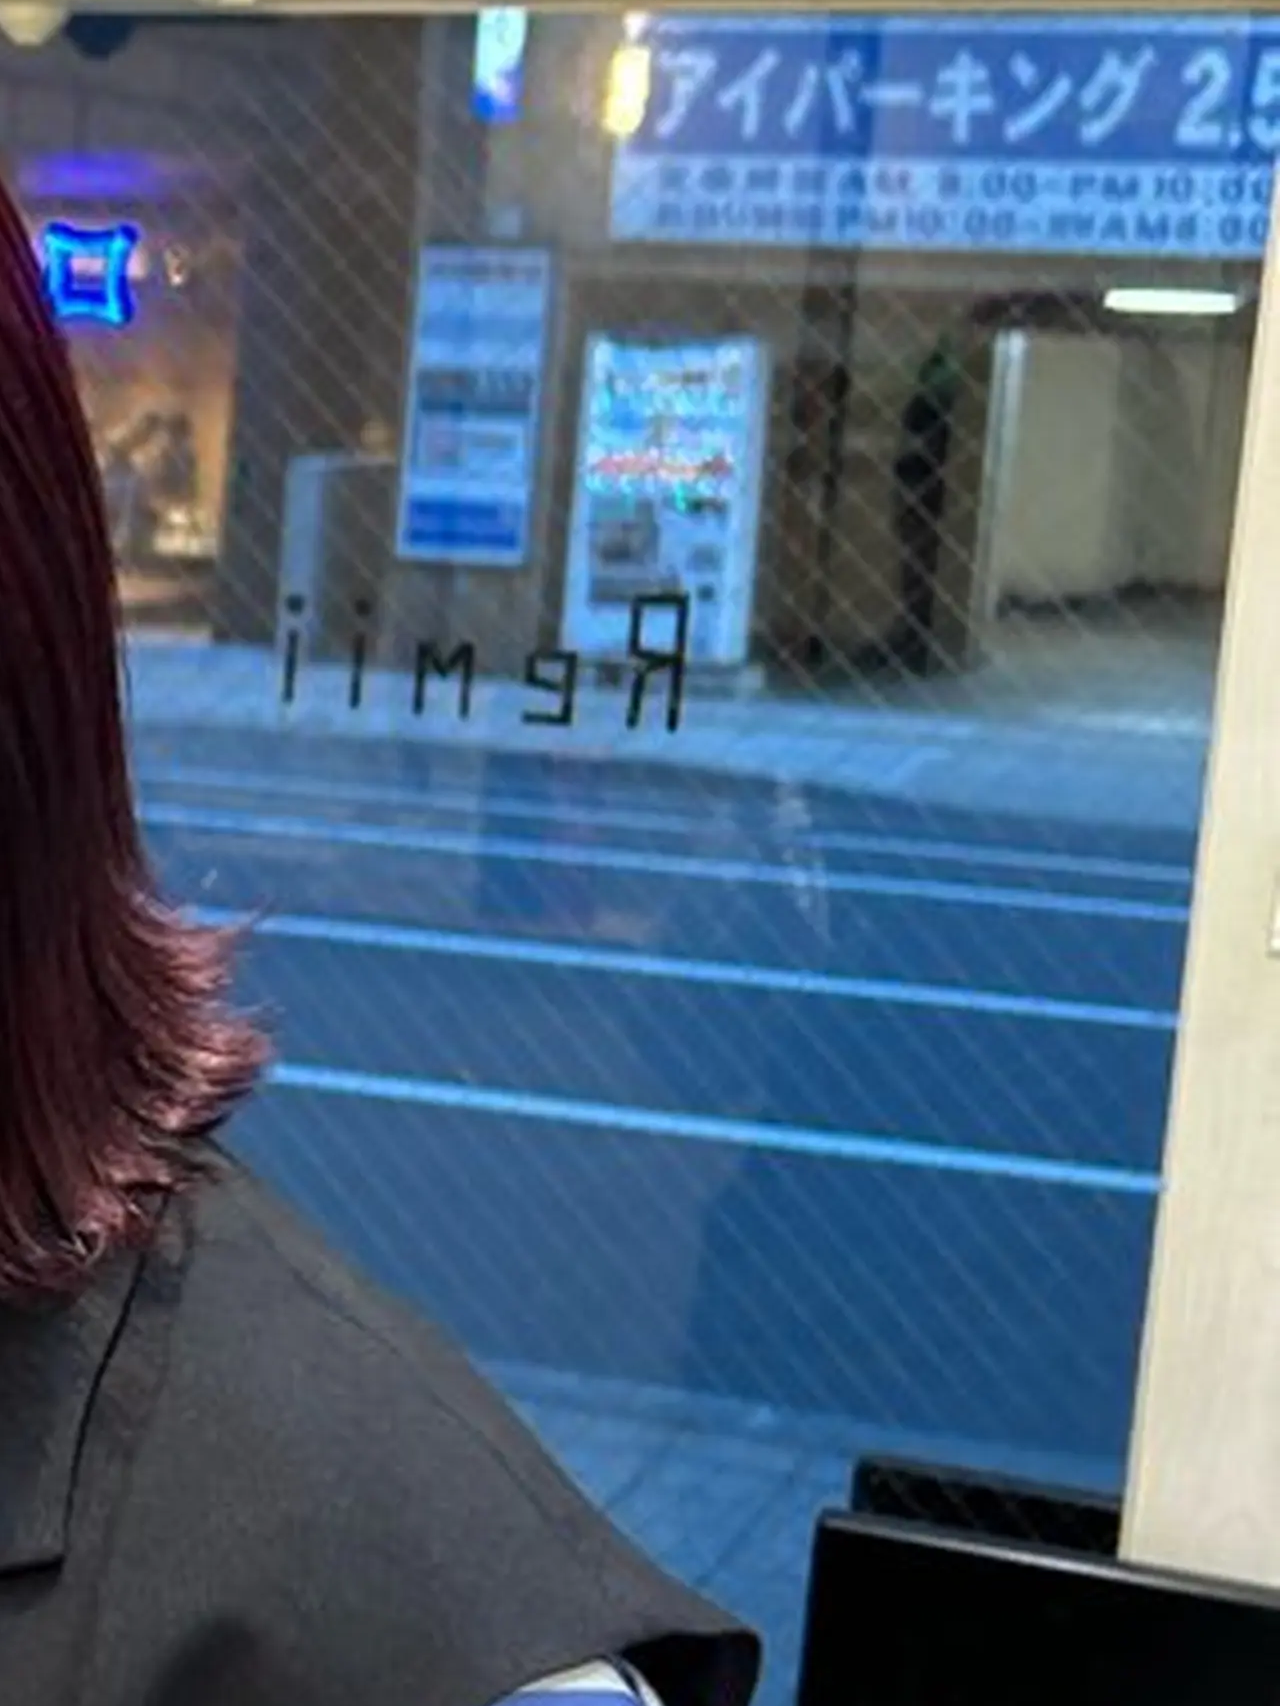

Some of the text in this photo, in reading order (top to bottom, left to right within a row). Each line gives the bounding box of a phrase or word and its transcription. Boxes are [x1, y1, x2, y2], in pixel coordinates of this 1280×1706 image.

[654, 45, 1156, 143] アイパーキング
